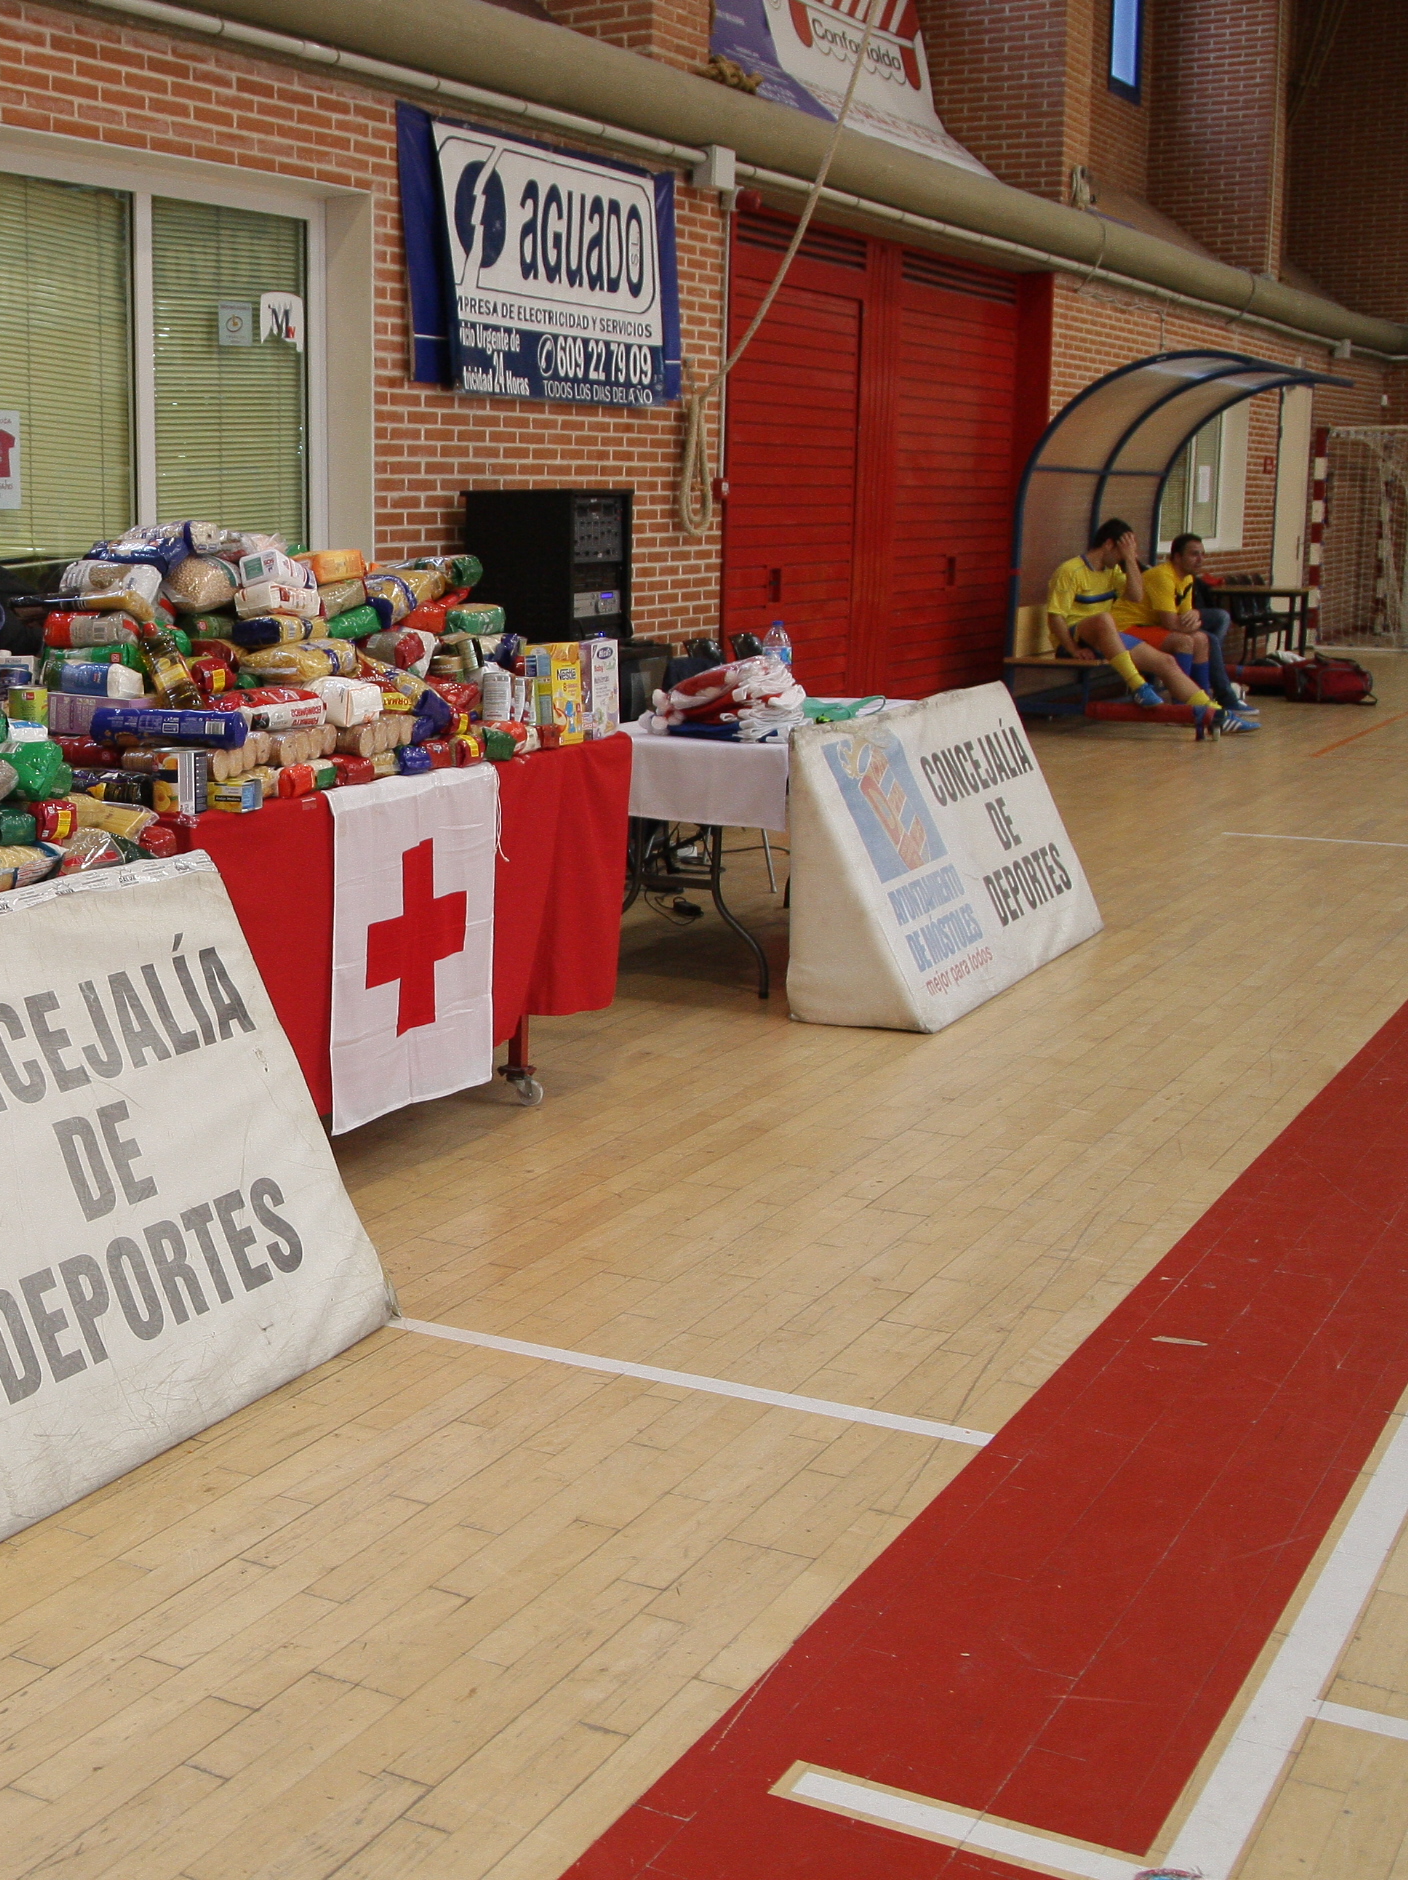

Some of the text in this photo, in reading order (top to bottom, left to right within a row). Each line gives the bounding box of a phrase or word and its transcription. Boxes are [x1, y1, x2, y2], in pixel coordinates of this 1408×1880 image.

[476, 323, 509, 354] Urgente
[510, 328, 520, 352] de
[502, 303, 515, 320] DE
[517, 305, 590, 329] ELECTRICIDAD
[592, 316, 597, 331] Y
[599, 318, 653, 338] SERVICIOS
[493, 351, 505, 393] 24
[506, 370, 530, 396] Horas
[556, 335, 653, 385] 609 22 79 09
[543, 380, 573, 398] TODOS
[574, 383, 591, 400] LOS
[612, 387, 627, 403] DEL
[628, 385, 653, 404] AÑO
[920, 718, 1033, 807] CONCEJALÍA
[985, 796, 1022, 851] DE
[887, 863, 965, 926] AYUNTAMIENTO
[983, 842, 1072, 927] DEPORTES
[905, 903, 983, 973] DE MÓSTOLES
[926, 946, 993, 997] mejor para todos
[52, 1100, 158, 1223] DE
